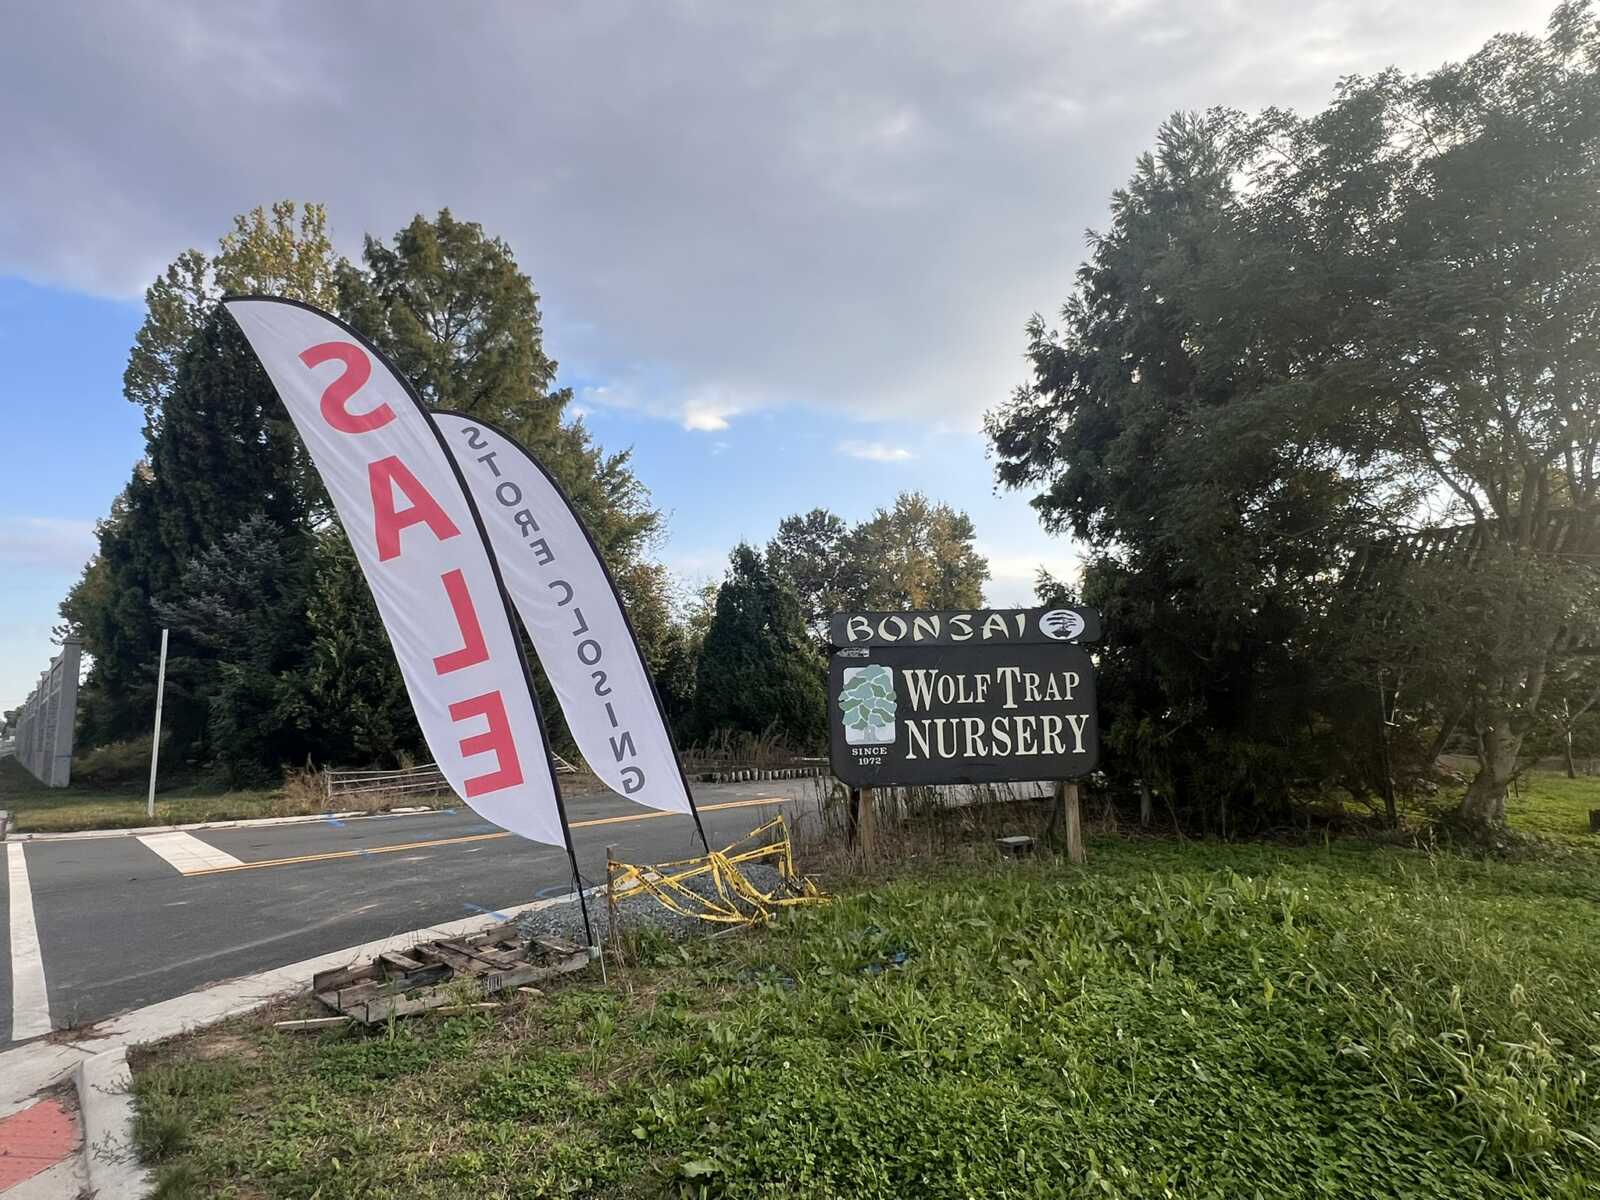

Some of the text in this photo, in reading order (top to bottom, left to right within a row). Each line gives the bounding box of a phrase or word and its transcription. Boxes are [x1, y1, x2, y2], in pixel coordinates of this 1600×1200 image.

[846, 613, 1026, 642] BONSAI
[902, 666, 1080, 711] WOLF TRAP
[851, 746, 888, 756] SINCE
[904, 714, 1090, 760] NURSERY
